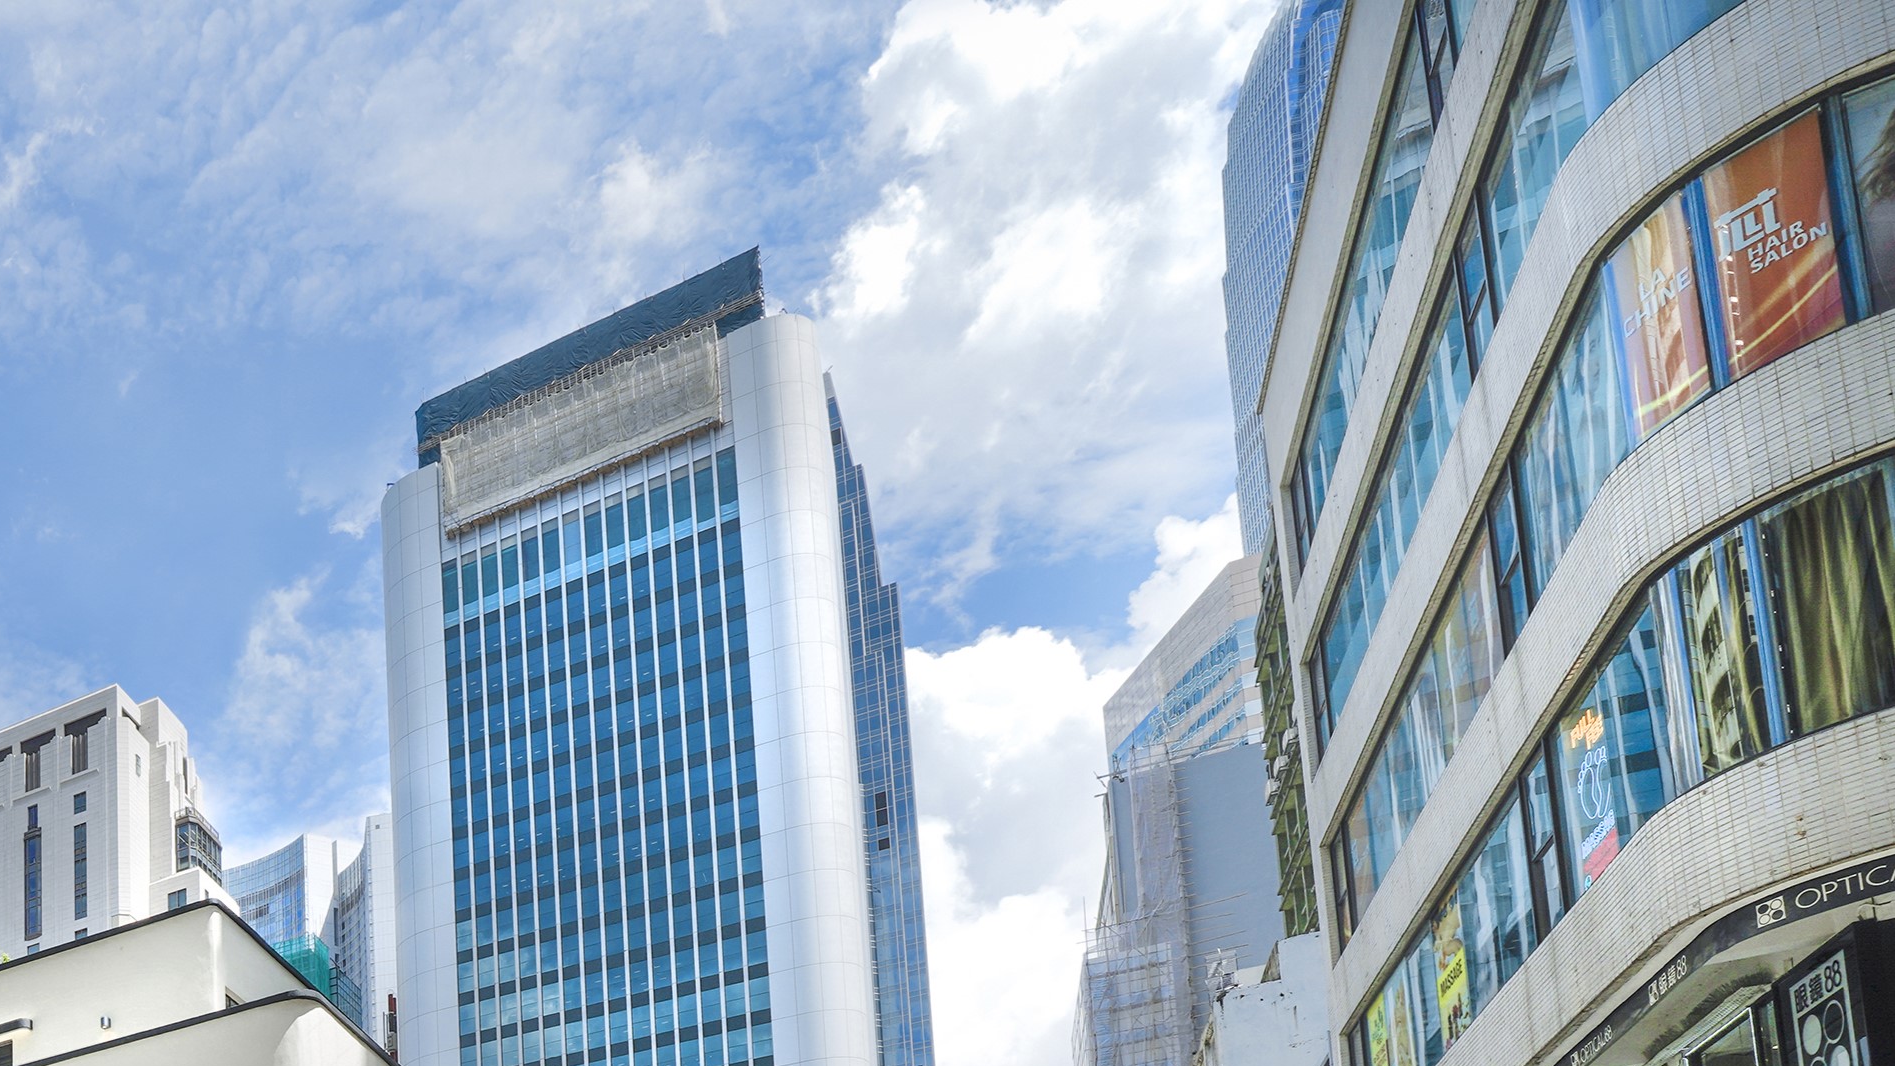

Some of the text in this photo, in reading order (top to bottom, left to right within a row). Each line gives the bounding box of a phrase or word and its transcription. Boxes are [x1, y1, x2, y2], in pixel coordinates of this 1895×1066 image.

[1747, 220, 1804, 261] HAIR
[1750, 222, 1828, 274] SALON
[1624, 266, 1691, 338] CHINE
[1639, 266, 1666, 301] LA
[1440, 958, 1463, 998] MASSAGE
[1794, 959, 1842, 1014] 眼鏡88
